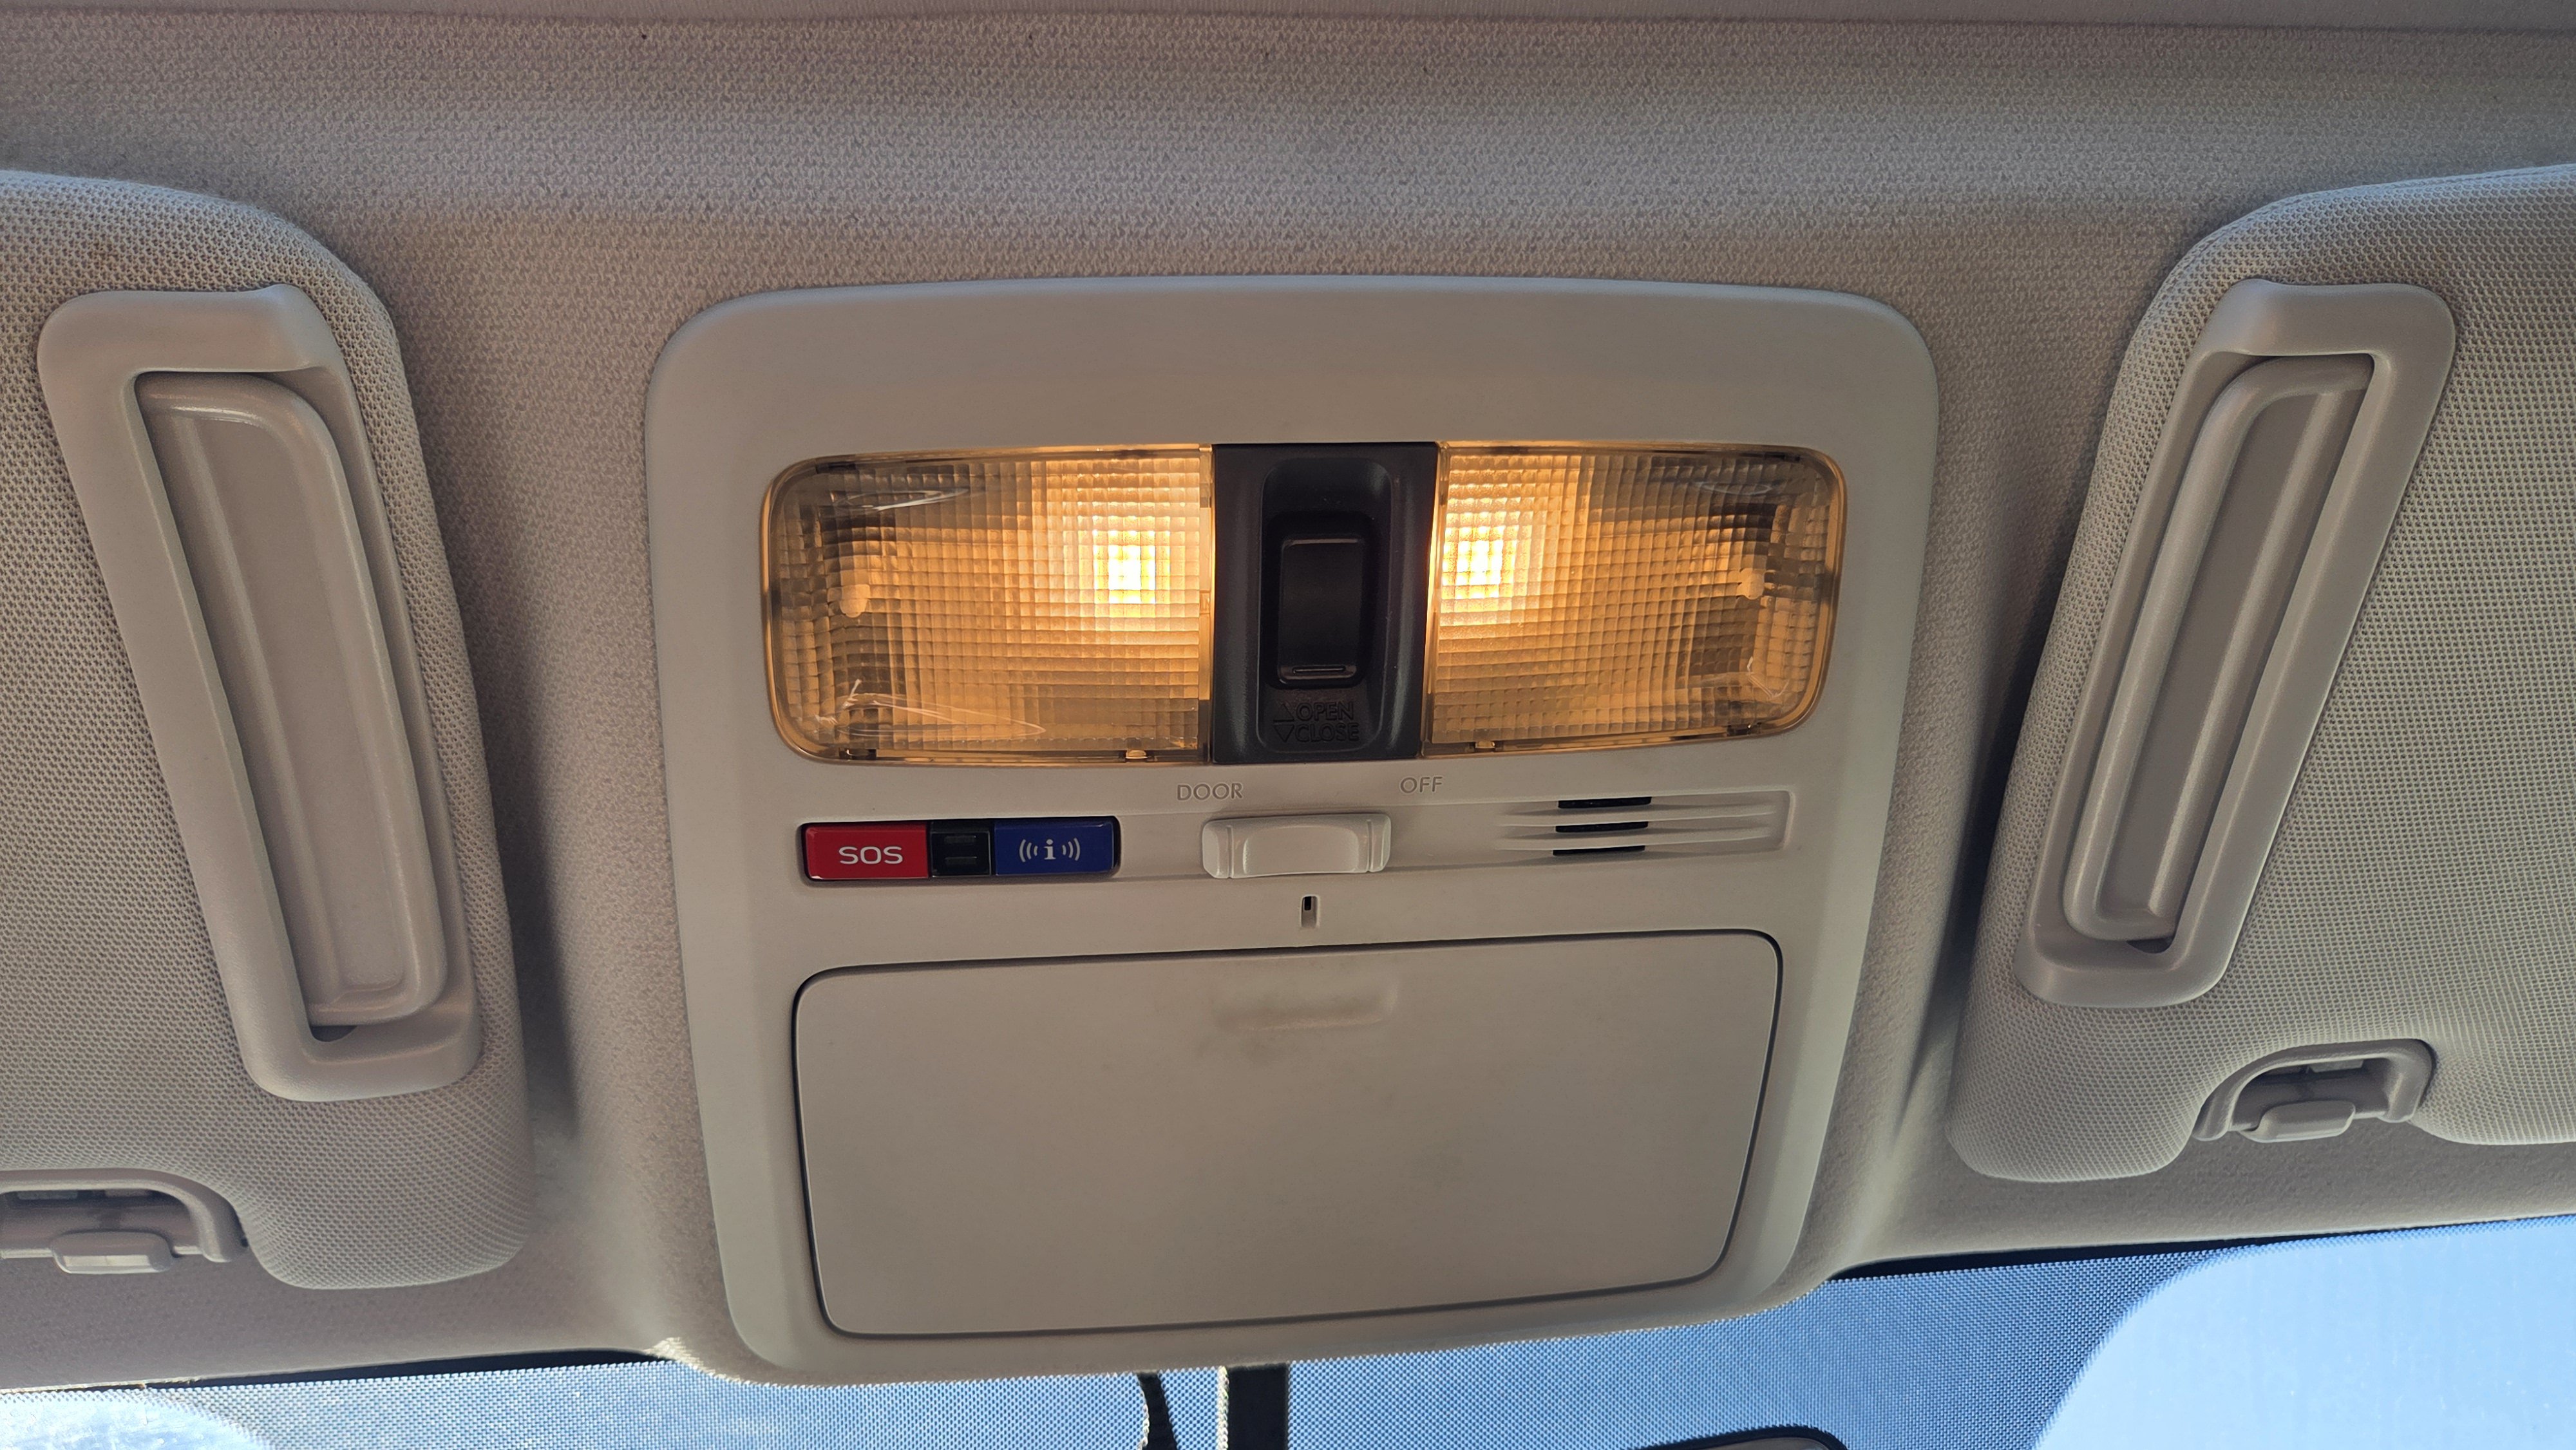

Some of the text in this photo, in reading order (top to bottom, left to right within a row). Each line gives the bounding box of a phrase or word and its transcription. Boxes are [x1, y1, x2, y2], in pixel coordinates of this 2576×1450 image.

[1296, 701, 1354, 722] OPEN
[1294, 722, 1359, 742] CLOSE
[1177, 782, 1243, 801] DOOR
[1400, 777, 1443, 794] OFF
[838, 846, 903, 865] SOS
